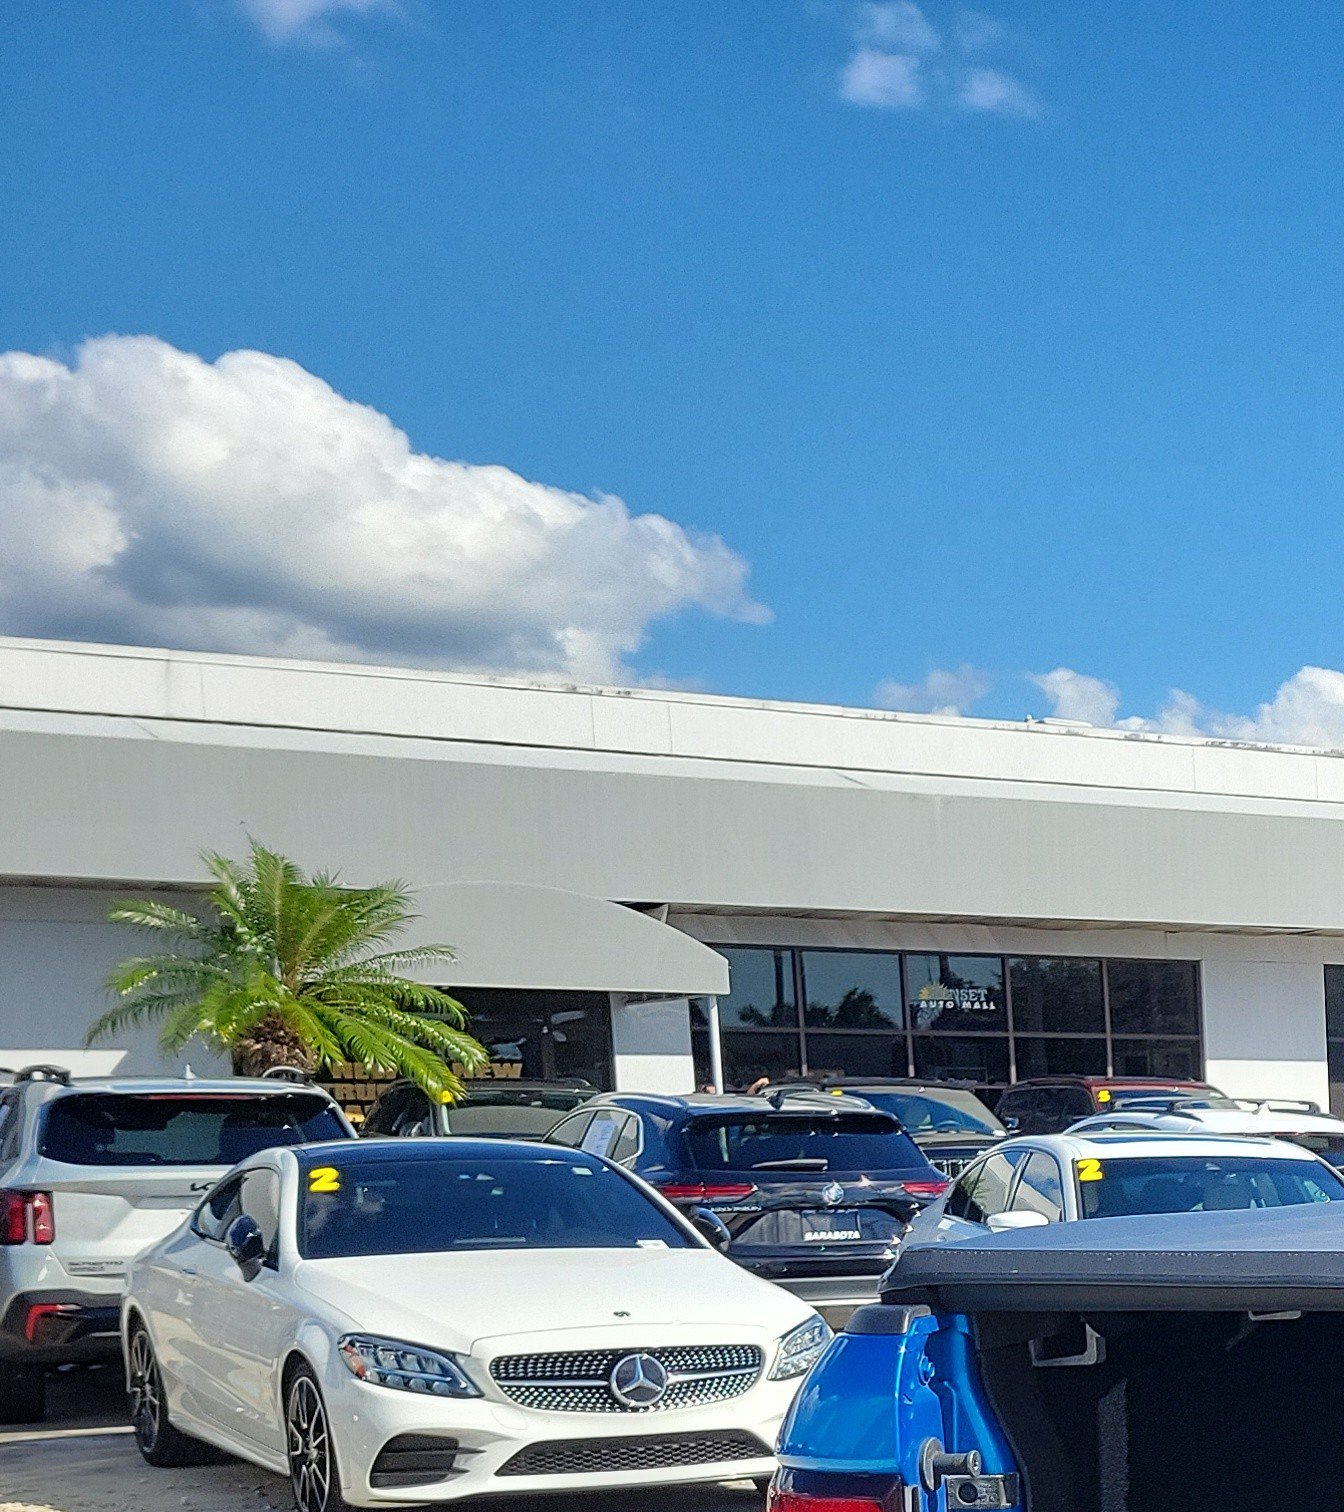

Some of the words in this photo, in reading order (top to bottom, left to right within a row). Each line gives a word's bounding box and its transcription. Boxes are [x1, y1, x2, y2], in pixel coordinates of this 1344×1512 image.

[919, 1000, 955, 1009] AUTO
[961, 1001, 996, 1010] MALL
[1077, 1158, 1103, 1181] 2
[308, 1166, 341, 1193] 2
[804, 1230, 861, 1241] SARASOTA
